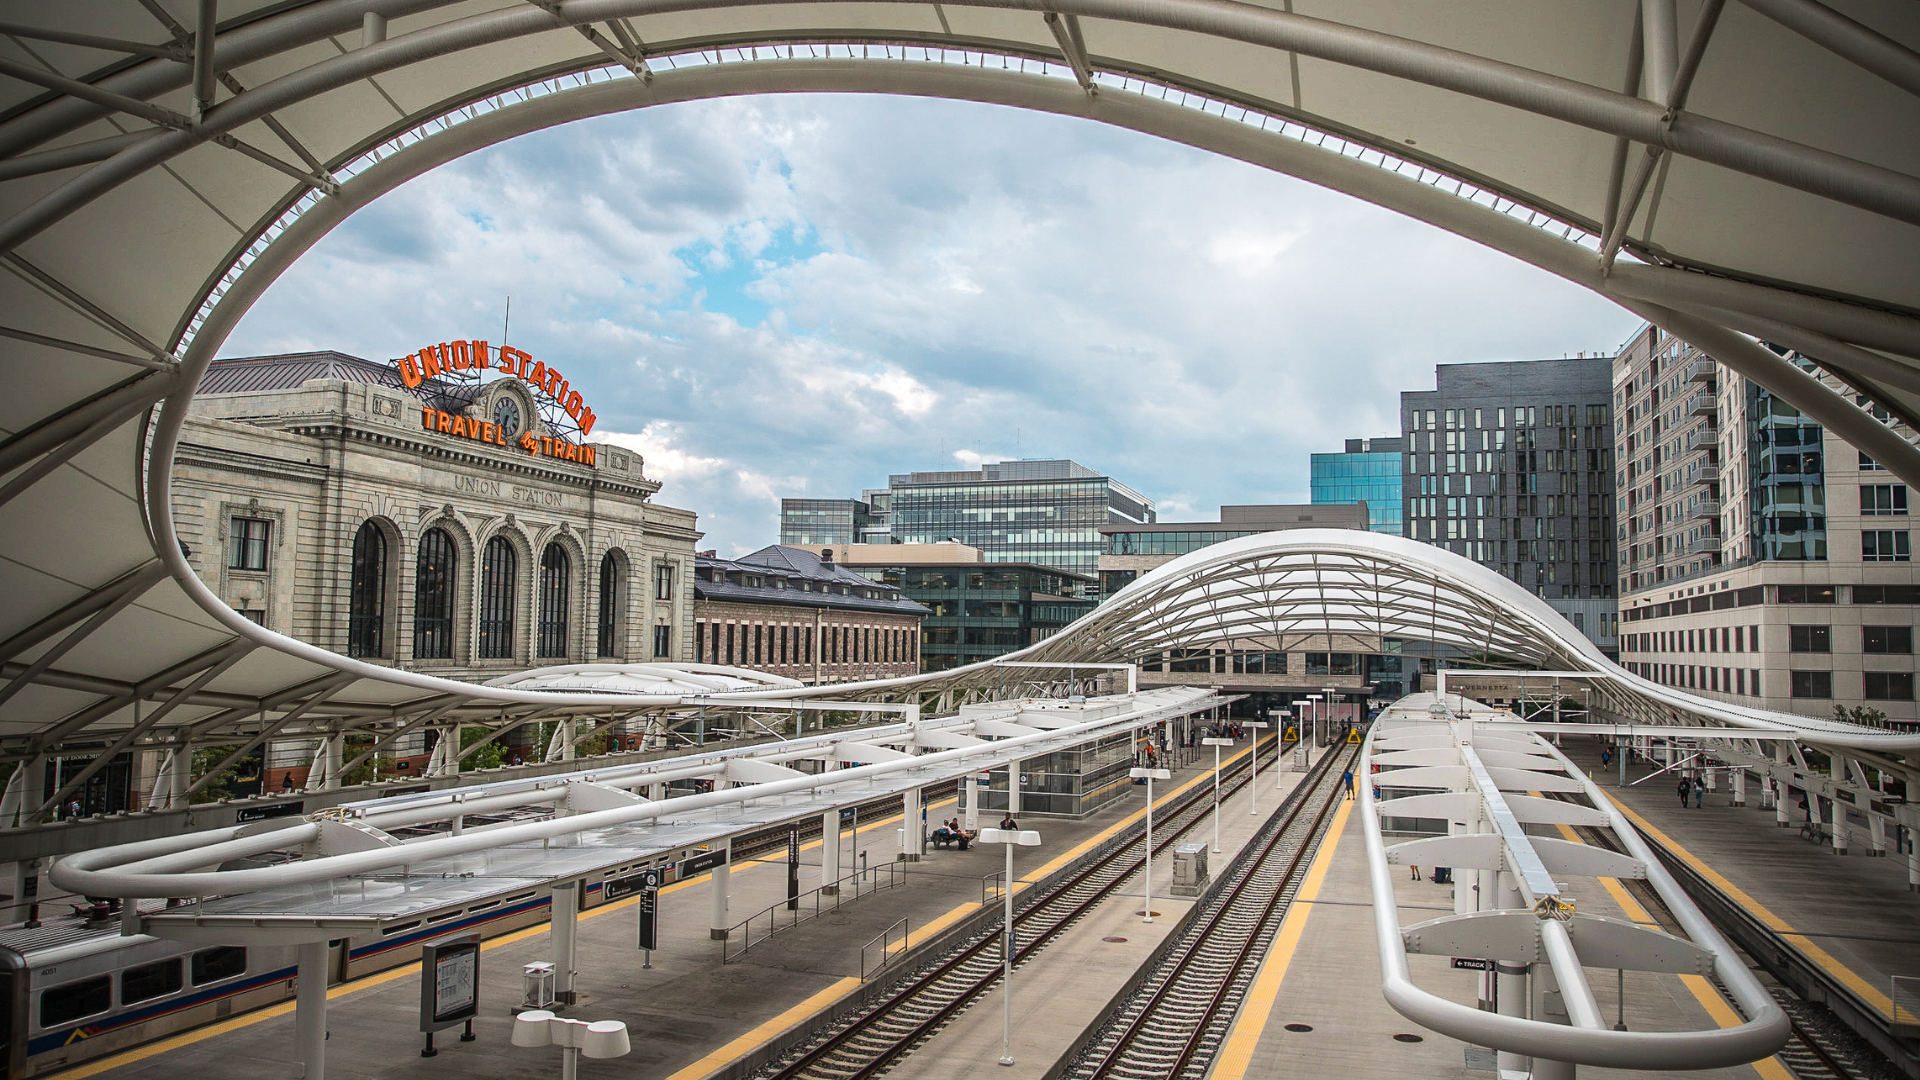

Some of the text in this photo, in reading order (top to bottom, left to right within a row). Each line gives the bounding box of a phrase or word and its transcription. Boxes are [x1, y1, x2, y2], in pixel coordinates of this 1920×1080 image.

[398, 340, 597, 436] UNION STATION
[422, 407, 596, 466] TRAVEL by TRAIN
[454, 475, 562, 507] UNION STATION
[1463, 961, 1485, 969] TRACK
